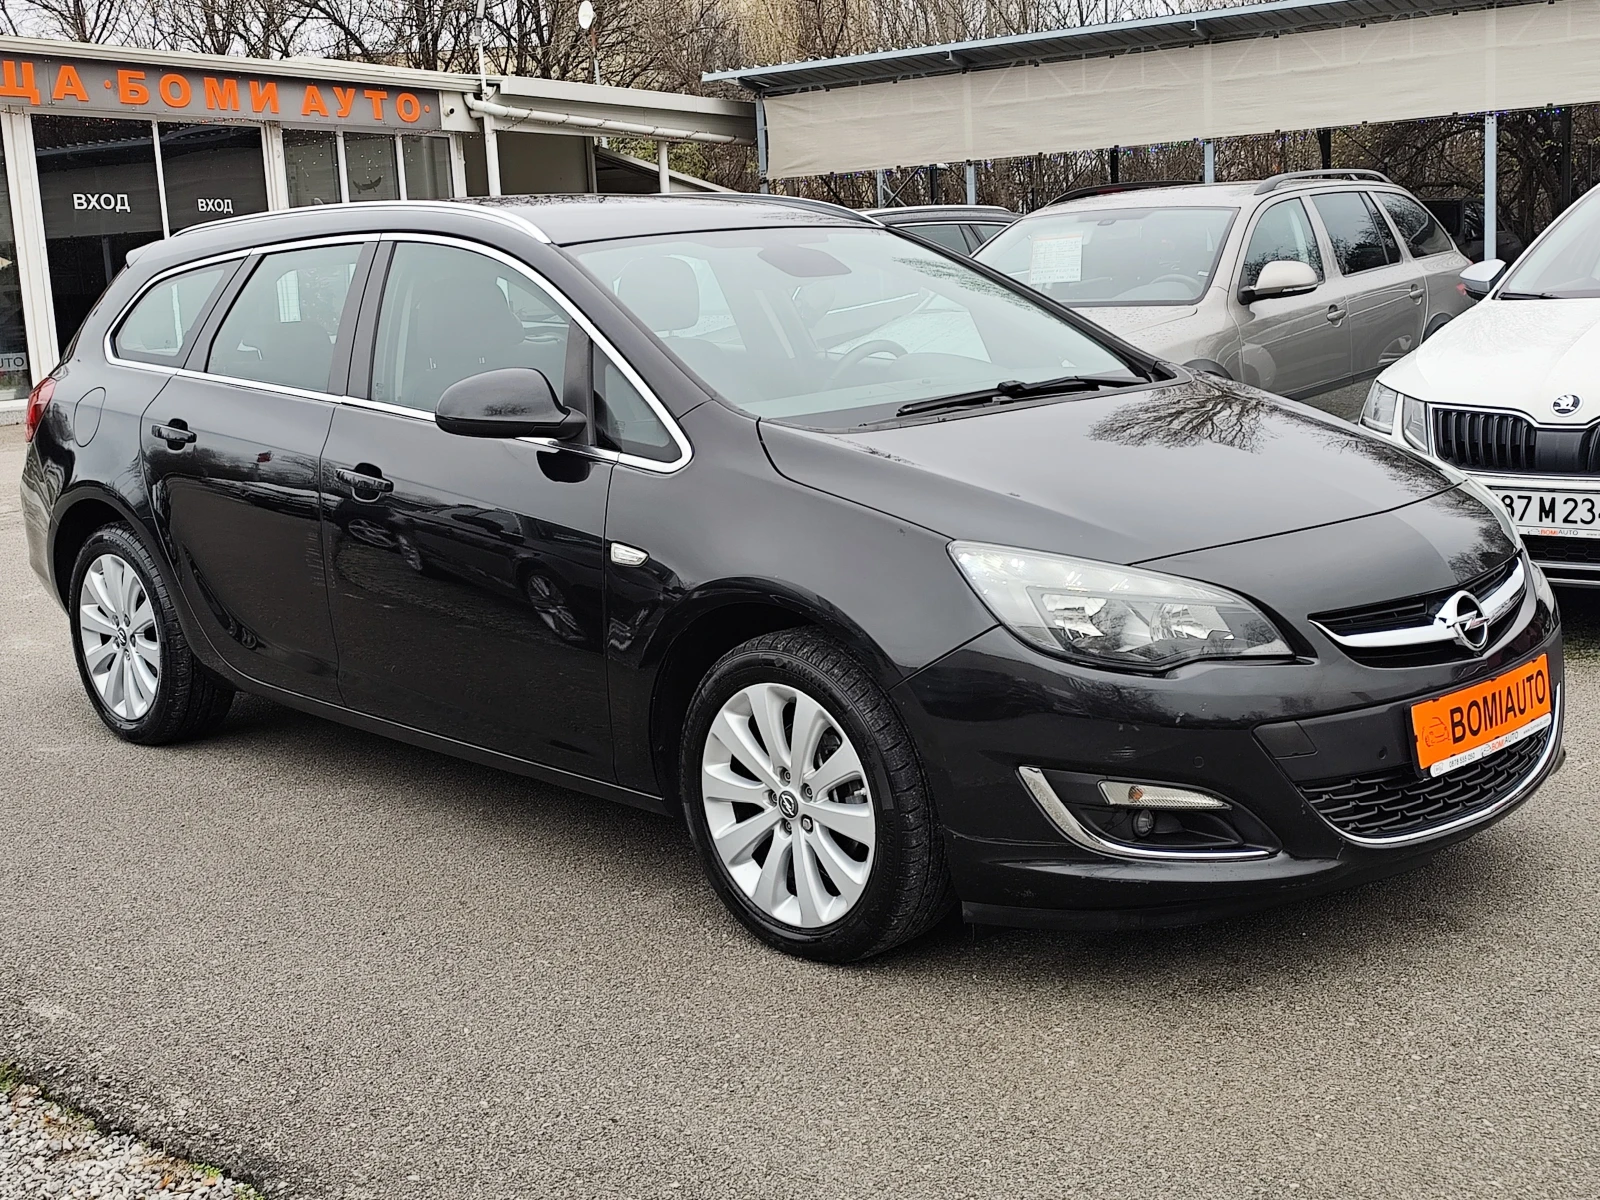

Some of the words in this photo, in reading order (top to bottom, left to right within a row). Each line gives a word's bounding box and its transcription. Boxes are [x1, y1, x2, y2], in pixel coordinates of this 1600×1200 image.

[117, 69, 280, 114] БОМИ
[301, 85, 421, 123] АУТО
[72, 193, 131, 213] ВХОД
[197, 198, 234, 214] ВХОД
[1496, 494, 1532, 522] 87
[1539, 496, 1556, 523] M
[1562, 498, 1600, 525] 23
[1449, 669, 1546, 745] BOMIAUTO
